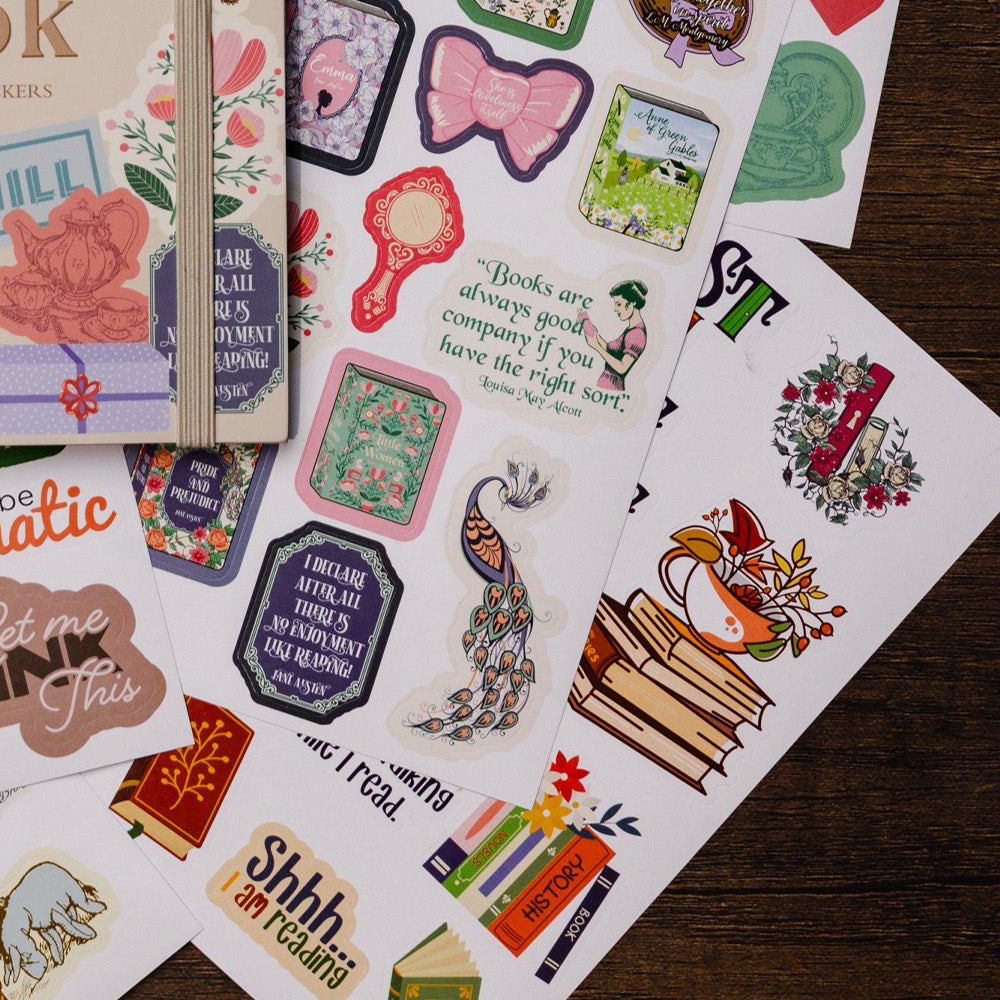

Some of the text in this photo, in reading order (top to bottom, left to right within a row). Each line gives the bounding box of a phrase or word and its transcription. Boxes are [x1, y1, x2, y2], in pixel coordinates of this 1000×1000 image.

[309, 52, 356, 84] Emma
[477, 257, 594, 310] “Books are
[459, 282, 590, 337] always good
[442, 308, 595, 370] company if you
[439, 334, 488, 366] have
[493, 353, 524, 377] the
[529, 368, 577, 397] right
[478, 374, 582, 418] Louisa May Alcott
[188, 475, 210, 493] AND
[190, 460, 219, 478] PRIDE
[170, 485, 221, 512] PREJUDICE
[294, 574, 362, 611] AFTER ALL
[303, 554, 369, 590] I DECLARE
[43, 608, 110, 641] me
[263, 614, 366, 659] NO ENJOYMENT
[294, 597, 351, 633] THERE IS
[263, 635, 354, 679] LIKE READING!
[39, 656, 141, 733] This
[271, 669, 332, 696] JANE AUSTEN
[346, 761, 406, 823] read.
[472, 828, 508, 868] NOVELS
[246, 835, 356, 969] Shhh...
[521, 853, 585, 922] HISTORY
[220, 870, 349, 990] I am reading
[564, 907, 591, 942] BOOK
